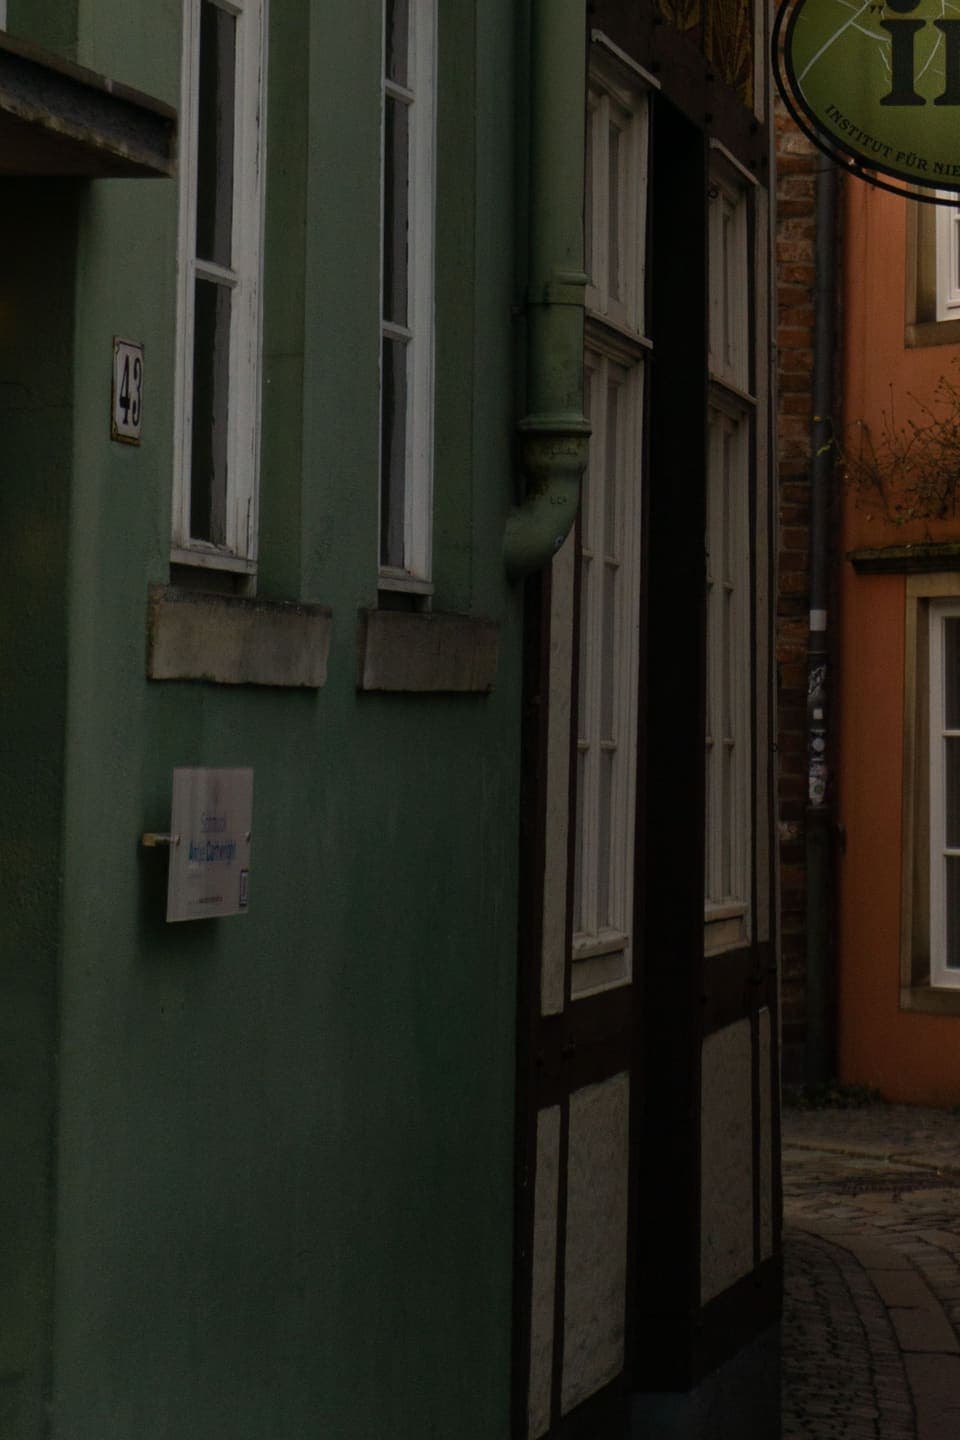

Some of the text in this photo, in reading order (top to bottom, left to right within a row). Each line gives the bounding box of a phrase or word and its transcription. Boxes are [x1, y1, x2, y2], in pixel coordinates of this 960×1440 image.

[825, 104, 894, 158] INSTITUT
[896, 148, 929, 171] FÜR
[119, 354, 142, 427] 43
